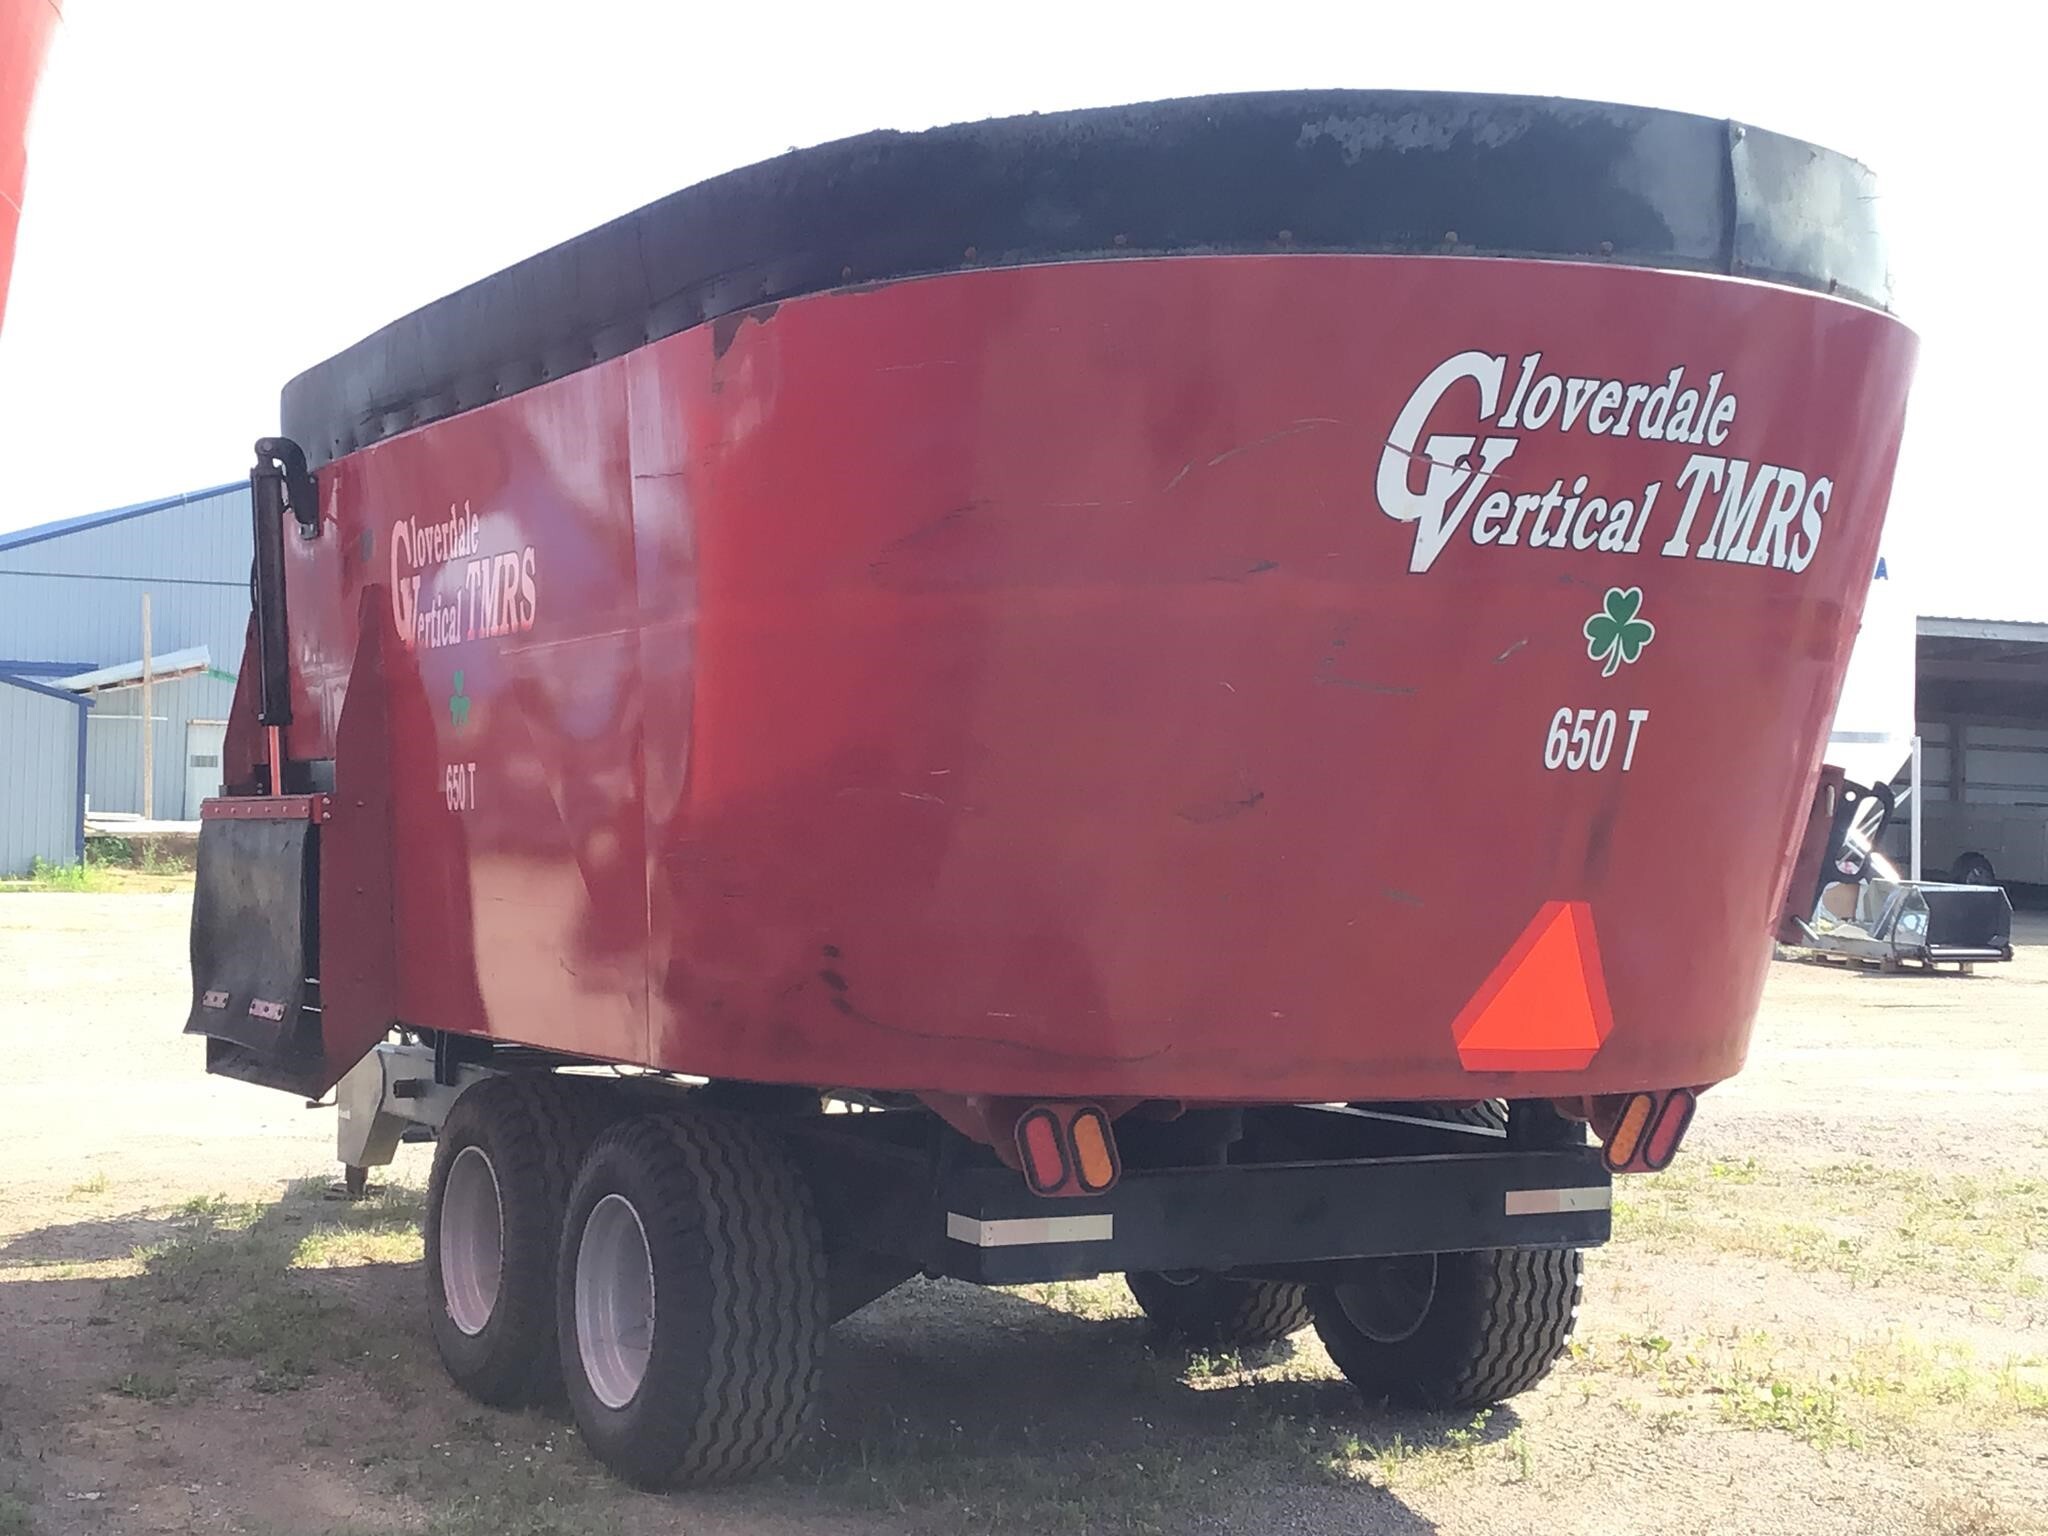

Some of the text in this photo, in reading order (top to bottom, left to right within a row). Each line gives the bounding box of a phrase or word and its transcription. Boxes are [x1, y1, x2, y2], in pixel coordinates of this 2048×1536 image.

[1375, 350, 1738, 522] Cloverdale
[1407, 435, 1834, 575] Vertical TMRS
[391, 500, 480, 640] Cloverdale
[400, 545, 537, 650] Vertical TMRS
[446, 761, 477, 811] 650 T
[1544, 706, 1650, 772] 650 T
